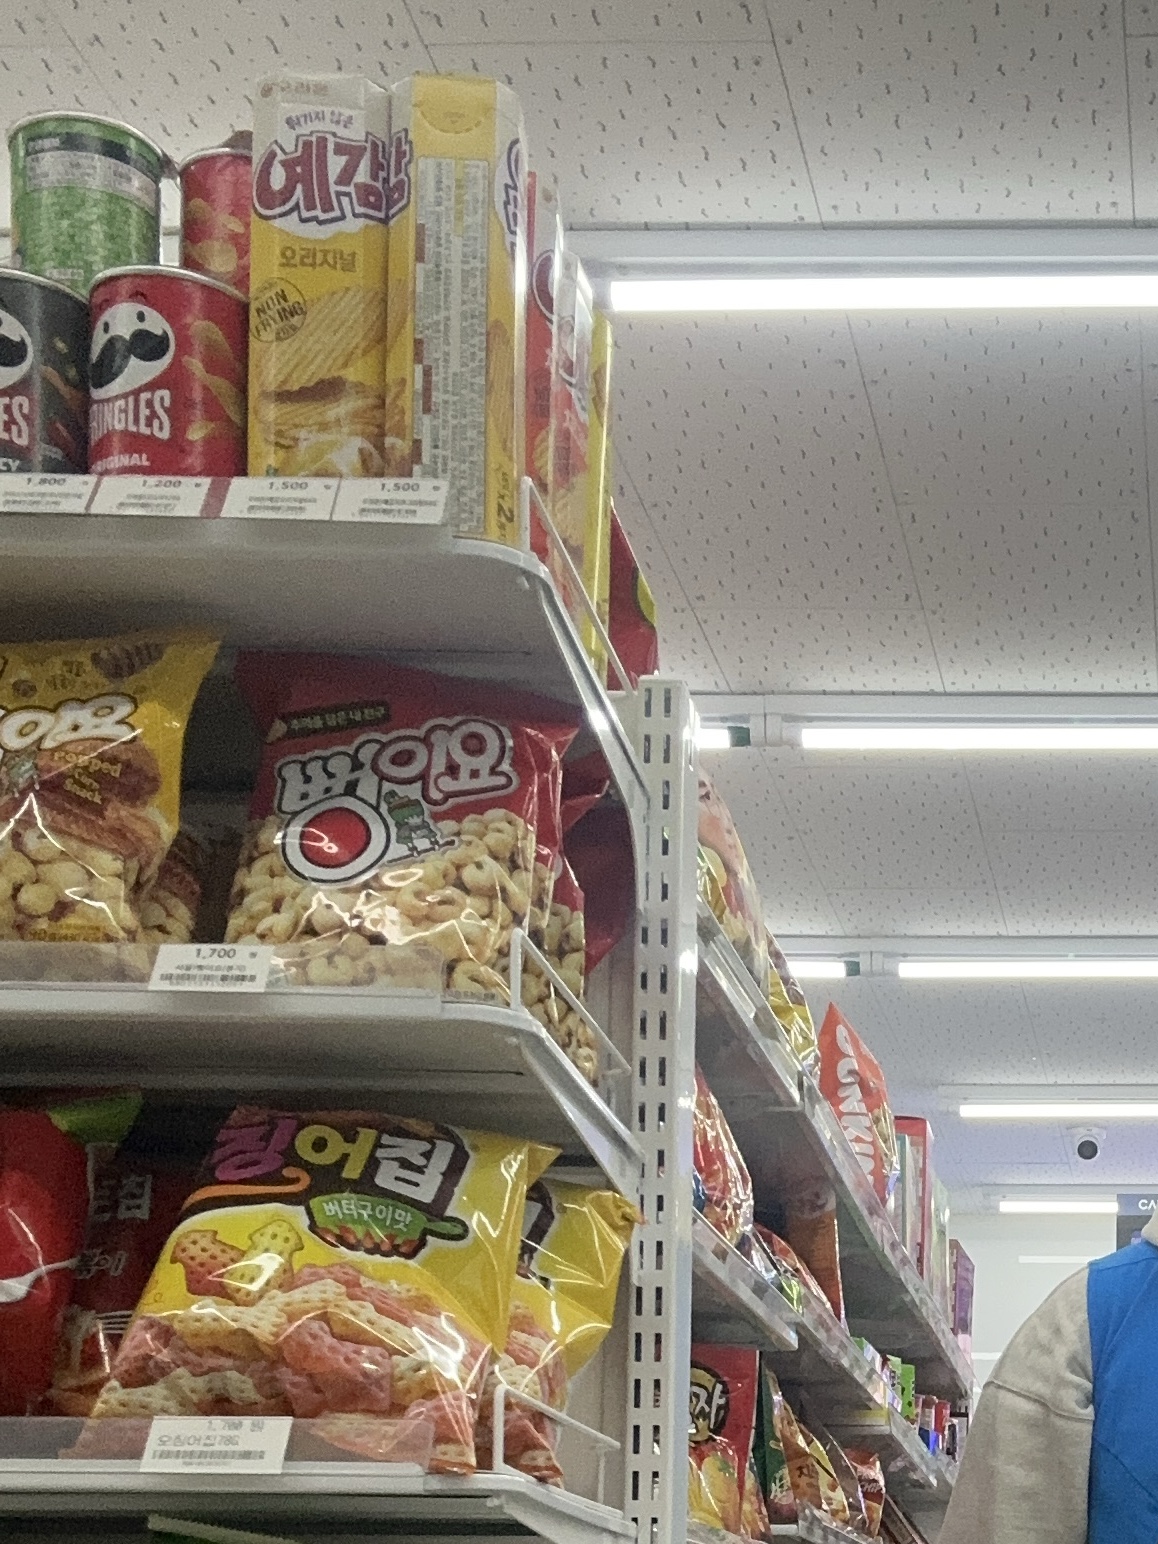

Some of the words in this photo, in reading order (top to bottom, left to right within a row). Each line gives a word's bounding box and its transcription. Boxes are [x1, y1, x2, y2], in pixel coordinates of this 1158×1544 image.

[254, 131, 387, 223] 예감
[278, 246, 357, 273] 오리지널
[255, 288, 289, 317] NON
[255, 301, 307, 337] FRYING
[268, 481, 309, 491] 1,500
[380, 482, 420, 492] 1,500
[195, 947, 237, 960] 1,700
[322, 1200, 413, 1232] 버터구이맛
